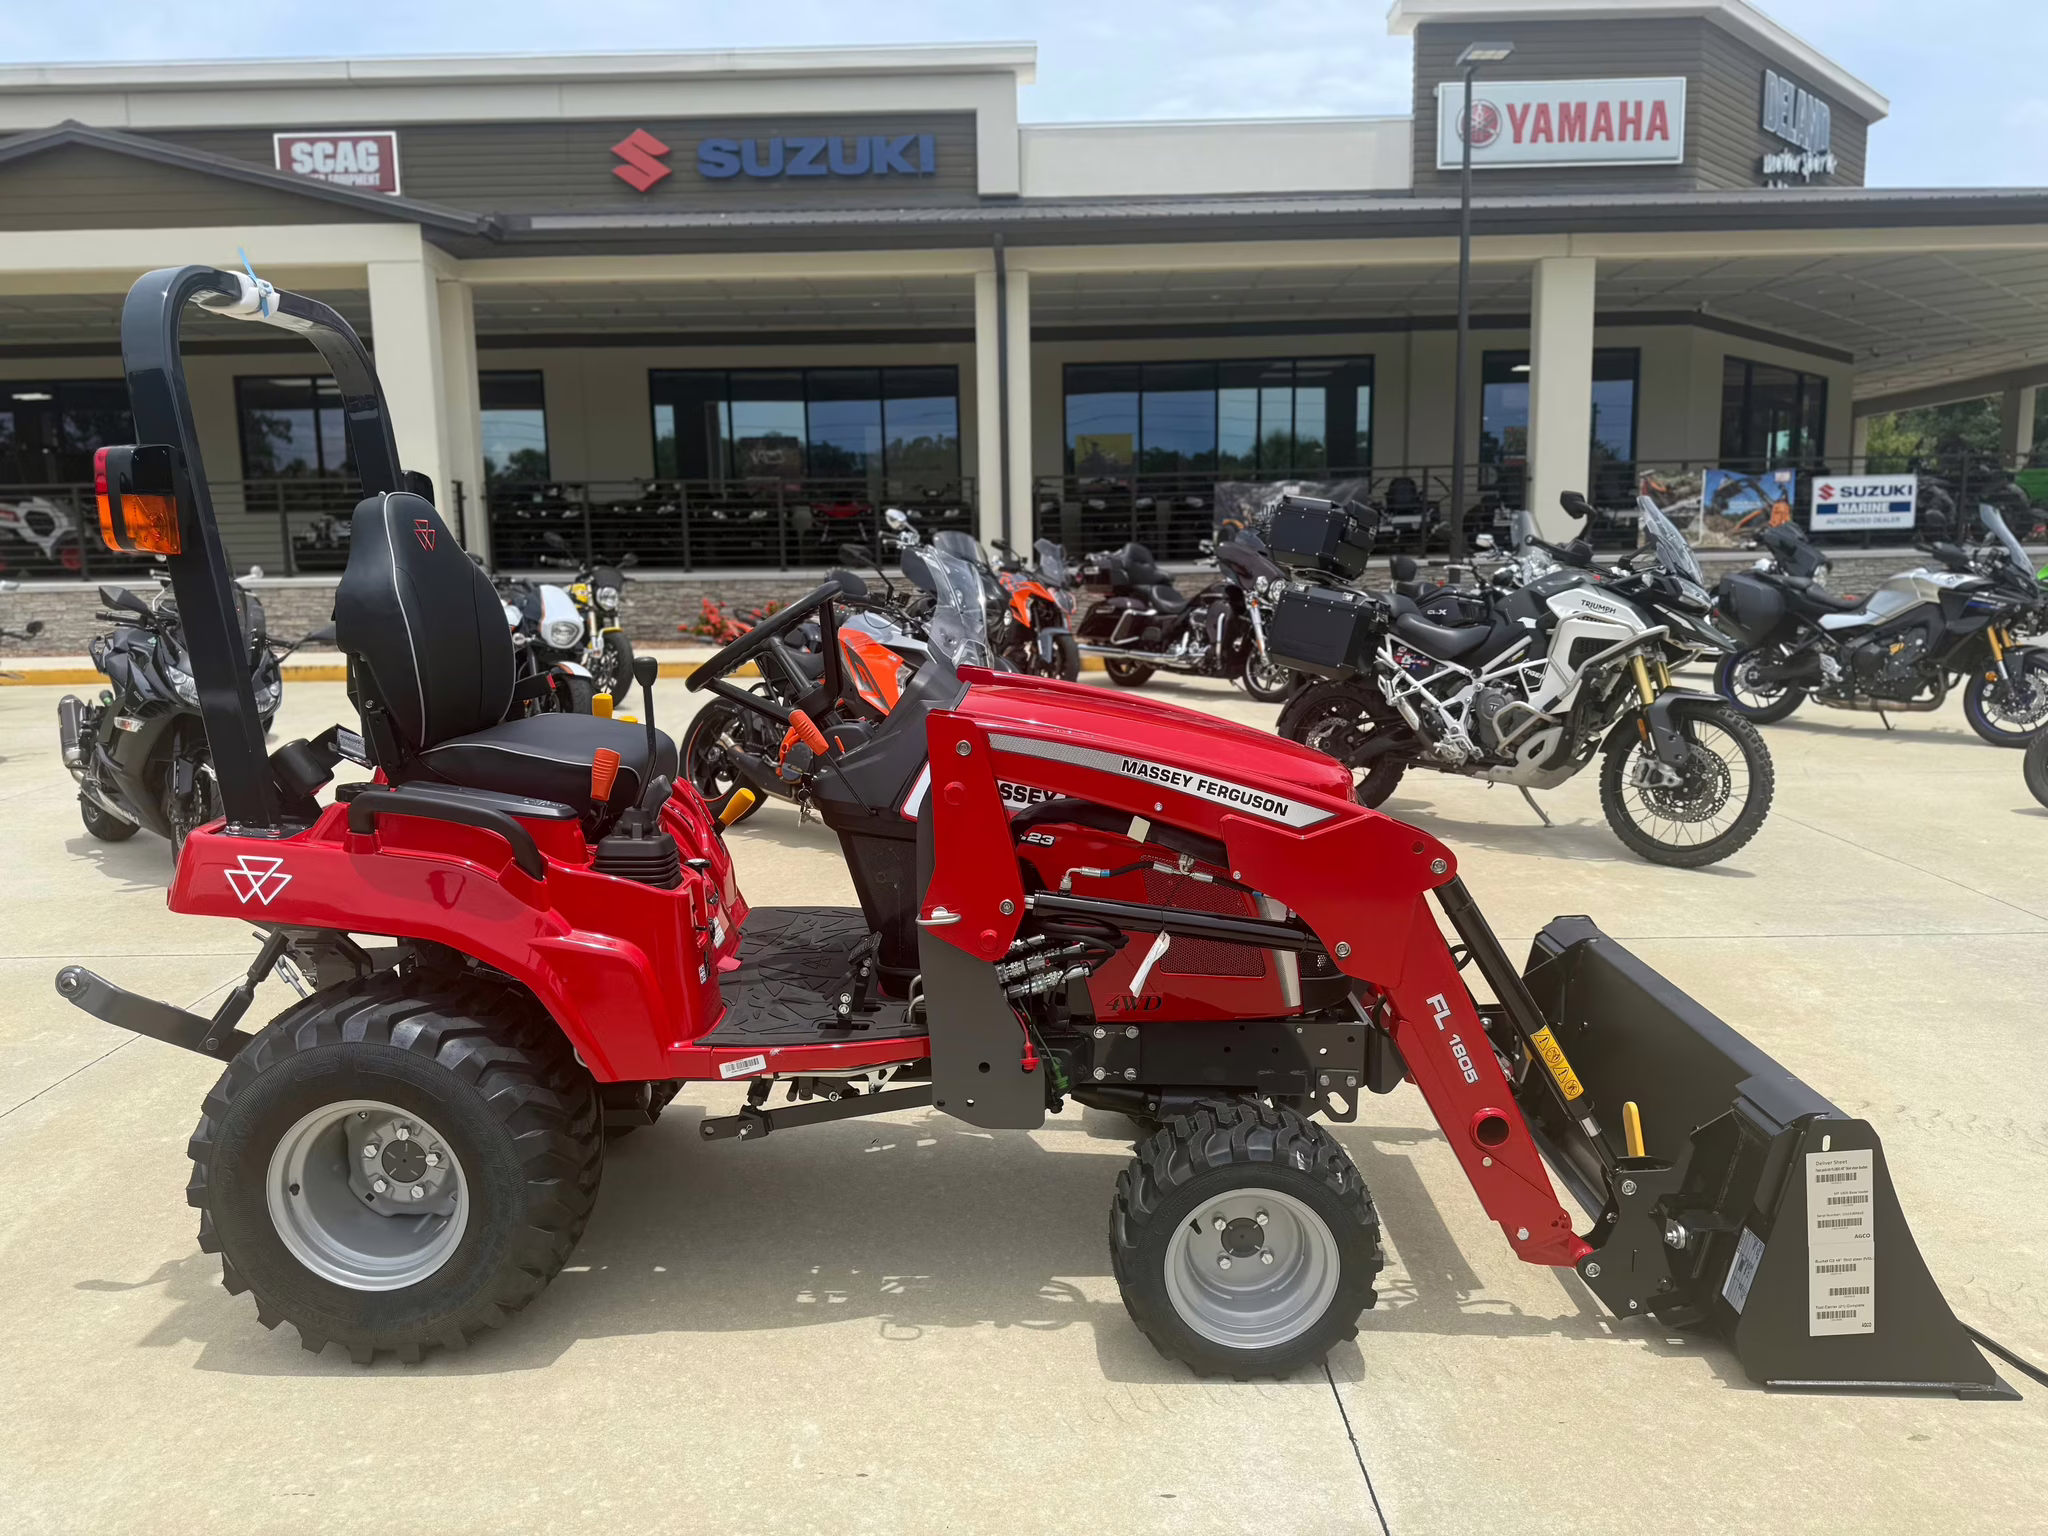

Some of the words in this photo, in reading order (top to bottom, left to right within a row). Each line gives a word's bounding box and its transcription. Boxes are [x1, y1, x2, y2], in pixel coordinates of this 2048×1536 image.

[1506, 100, 1670, 144] YAMAHA
[290, 140, 380, 174] SCAG
[697, 133, 936, 178] SUZUKI
[1840, 485, 1912, 498] SUZUKI
[1837, 502, 1890, 514] MARINE
[1581, 599, 1617, 615] TRIUMPH
[1000, 783, 1057, 804] SSEY
[1121, 759, 1193, 788] MASSEY
[1196, 779, 1289, 817] FERGUSON
[1105, 994, 1162, 1011] 4WD
[1425, 993, 1452, 1031] FL
[1449, 1033, 1479, 1084] 1805
